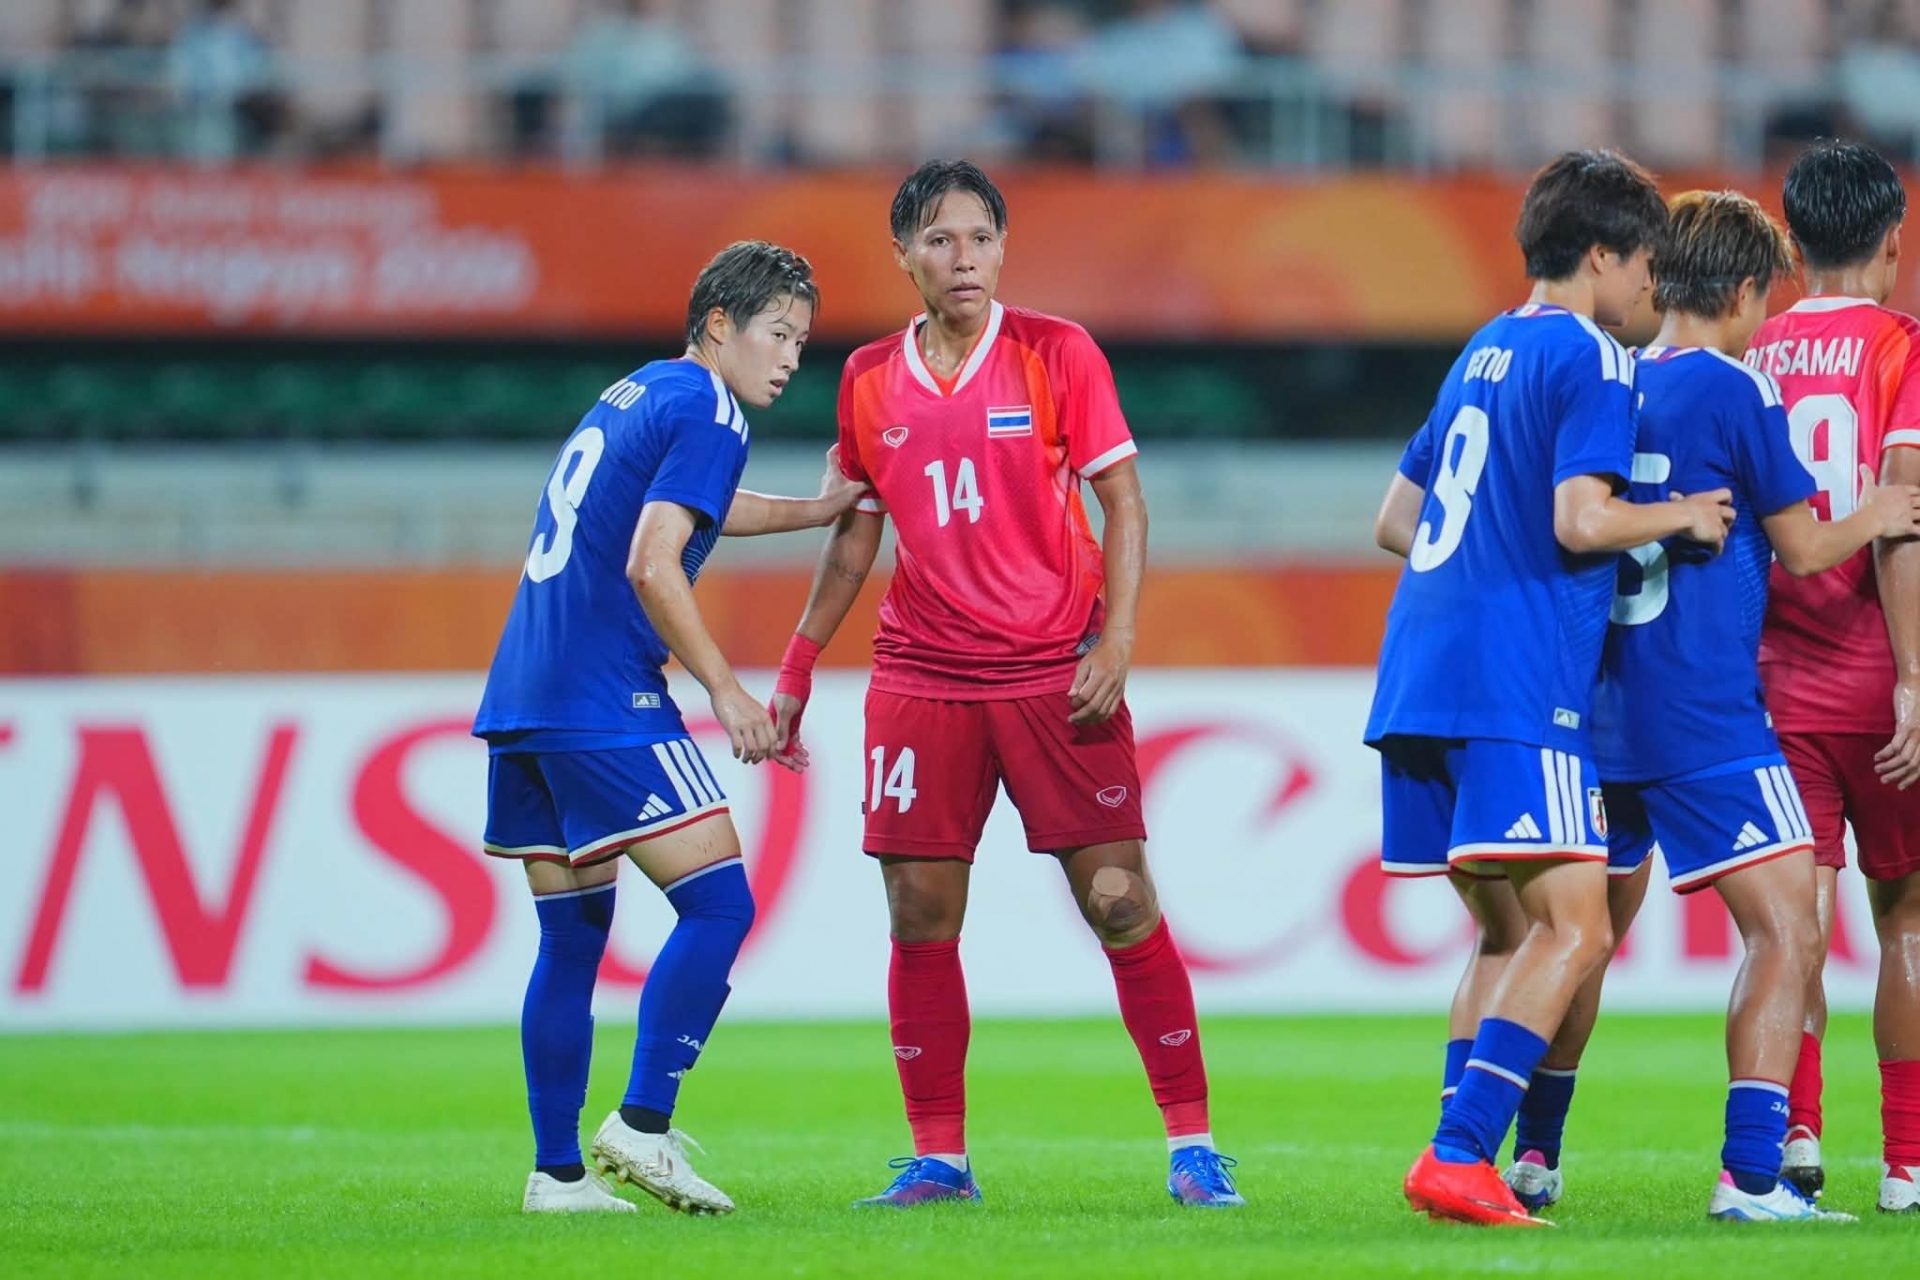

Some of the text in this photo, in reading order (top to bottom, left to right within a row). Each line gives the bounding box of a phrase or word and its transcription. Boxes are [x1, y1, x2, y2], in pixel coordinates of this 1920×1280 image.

[924, 456, 985, 528] 14
[1780, 393, 1859, 538] 9
[870, 745, 917, 814] 14
[0, 718, 816, 996] NSO
[676, 1034, 704, 1052] JA
